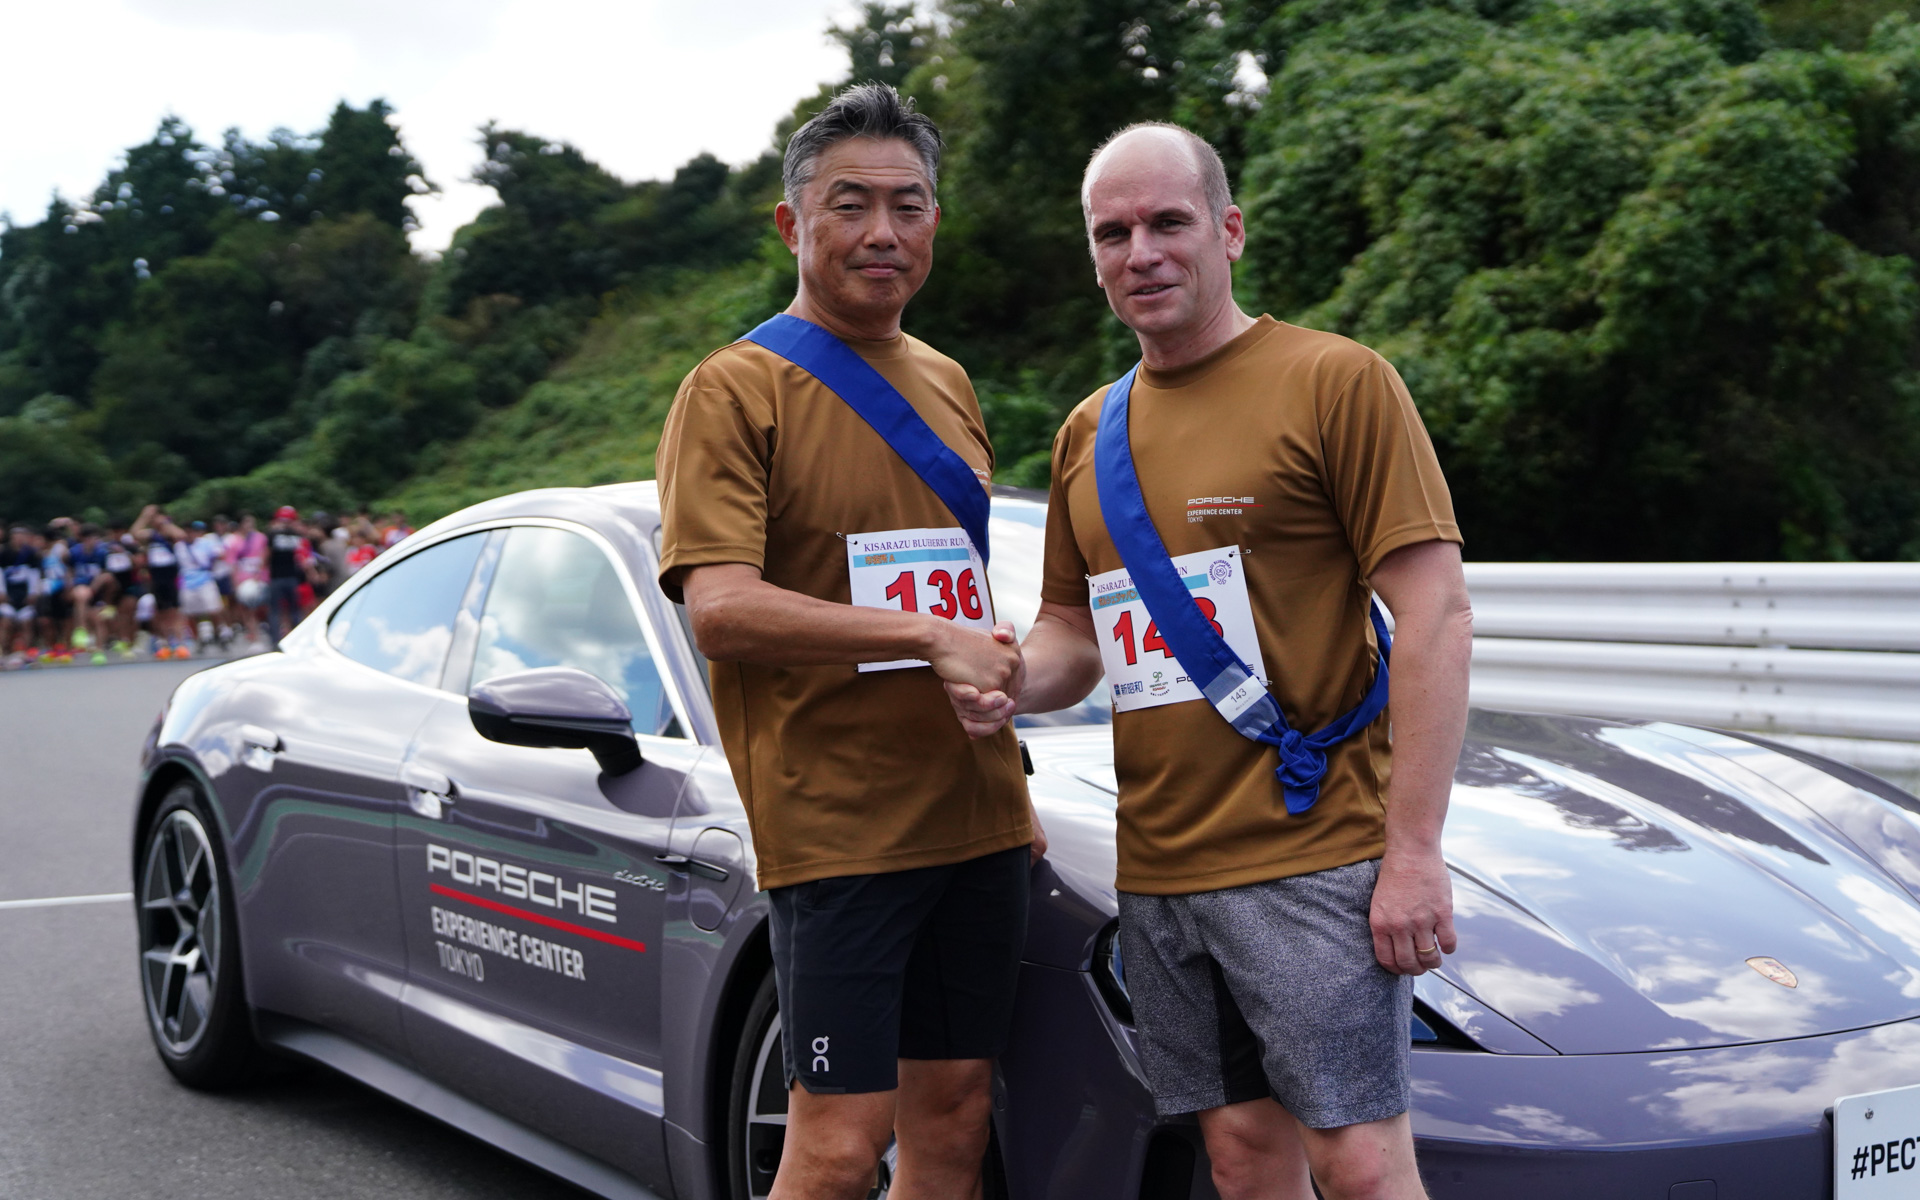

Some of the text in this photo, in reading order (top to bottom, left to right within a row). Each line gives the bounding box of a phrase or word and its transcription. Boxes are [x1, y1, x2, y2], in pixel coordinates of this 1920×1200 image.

[1187, 496, 1255, 505] PORSCHE
[1187, 508, 1217, 517] EXPERIENCE
[864, 540, 911, 552] KISARAZU
[949, 537, 966, 547] RUN
[885, 568, 983, 621] 136
[1097, 578, 1127, 593] KISARAZU
[1230, 687, 1247, 703] 143
[427, 843, 617, 923] PORSCHE
[430, 906, 586, 981] EXPERIENCE CENTER
[435, 940, 485, 982] TOKYO
[1851, 1136, 1920, 1180] #PEC
